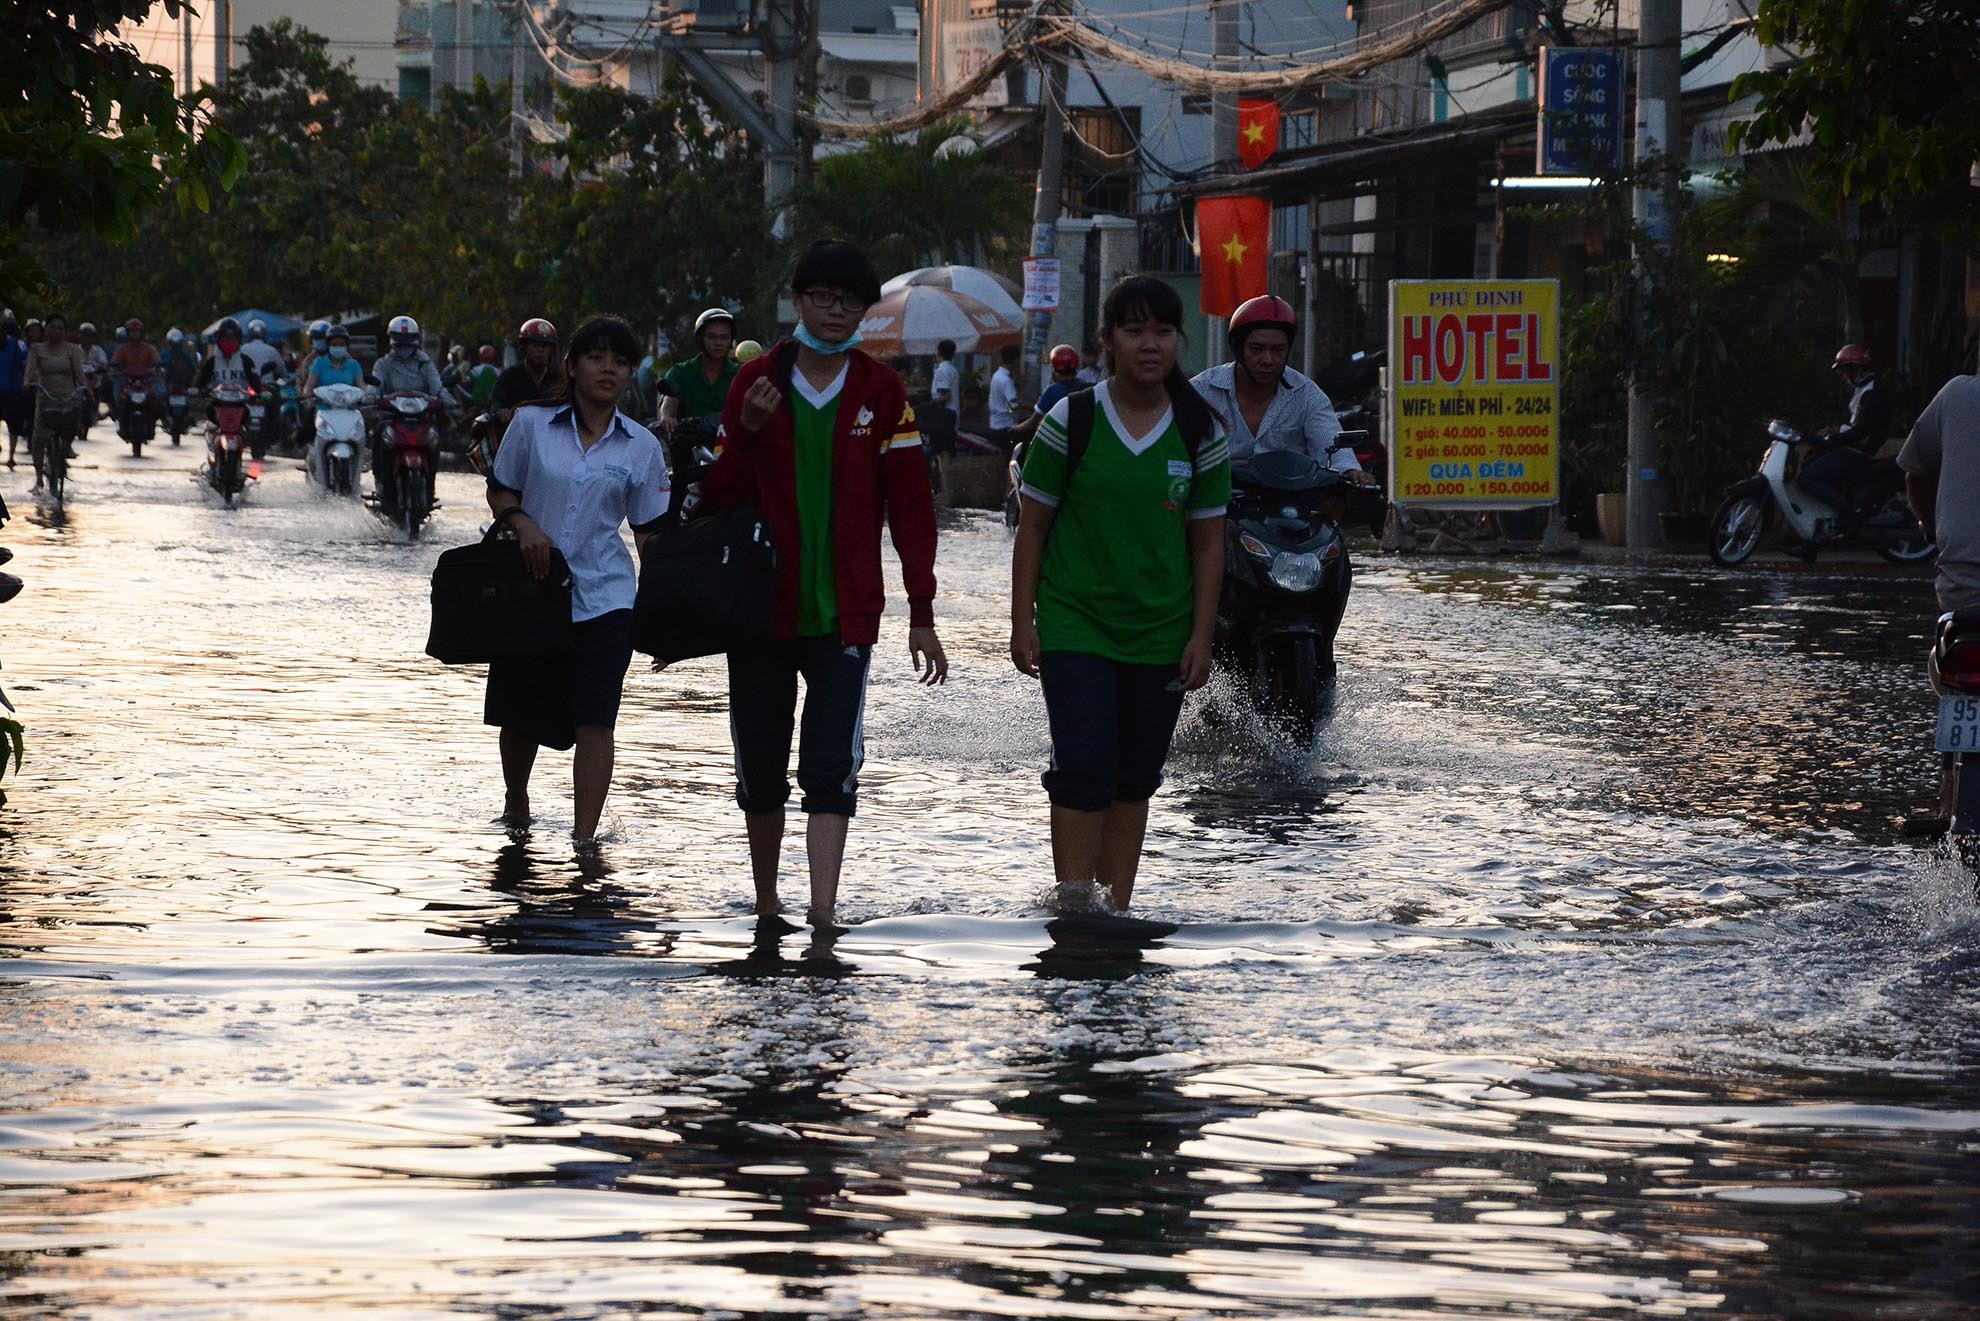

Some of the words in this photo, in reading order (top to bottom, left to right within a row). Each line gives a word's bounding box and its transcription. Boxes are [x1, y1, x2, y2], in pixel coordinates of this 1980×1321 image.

[1403, 313, 1552, 384] HOTEL
[1403, 398, 1435, 416] WIFI:
[1440, 389, 1475, 415] MIỄN
[1480, 391, 1503, 415] PHÍ
[1515, 397, 1551, 415] 24/24
[1404, 427, 1411, 439] 1
[1443, 426, 1486, 439] 40.000
[1404, 445, 1412, 458] 2
[1443, 444, 1486, 457] 60.000
[1430, 463, 1473, 479] QUA
[1479, 458, 1525, 478] ĐÊM
[1404, 482, 1464, 496] 120.000
